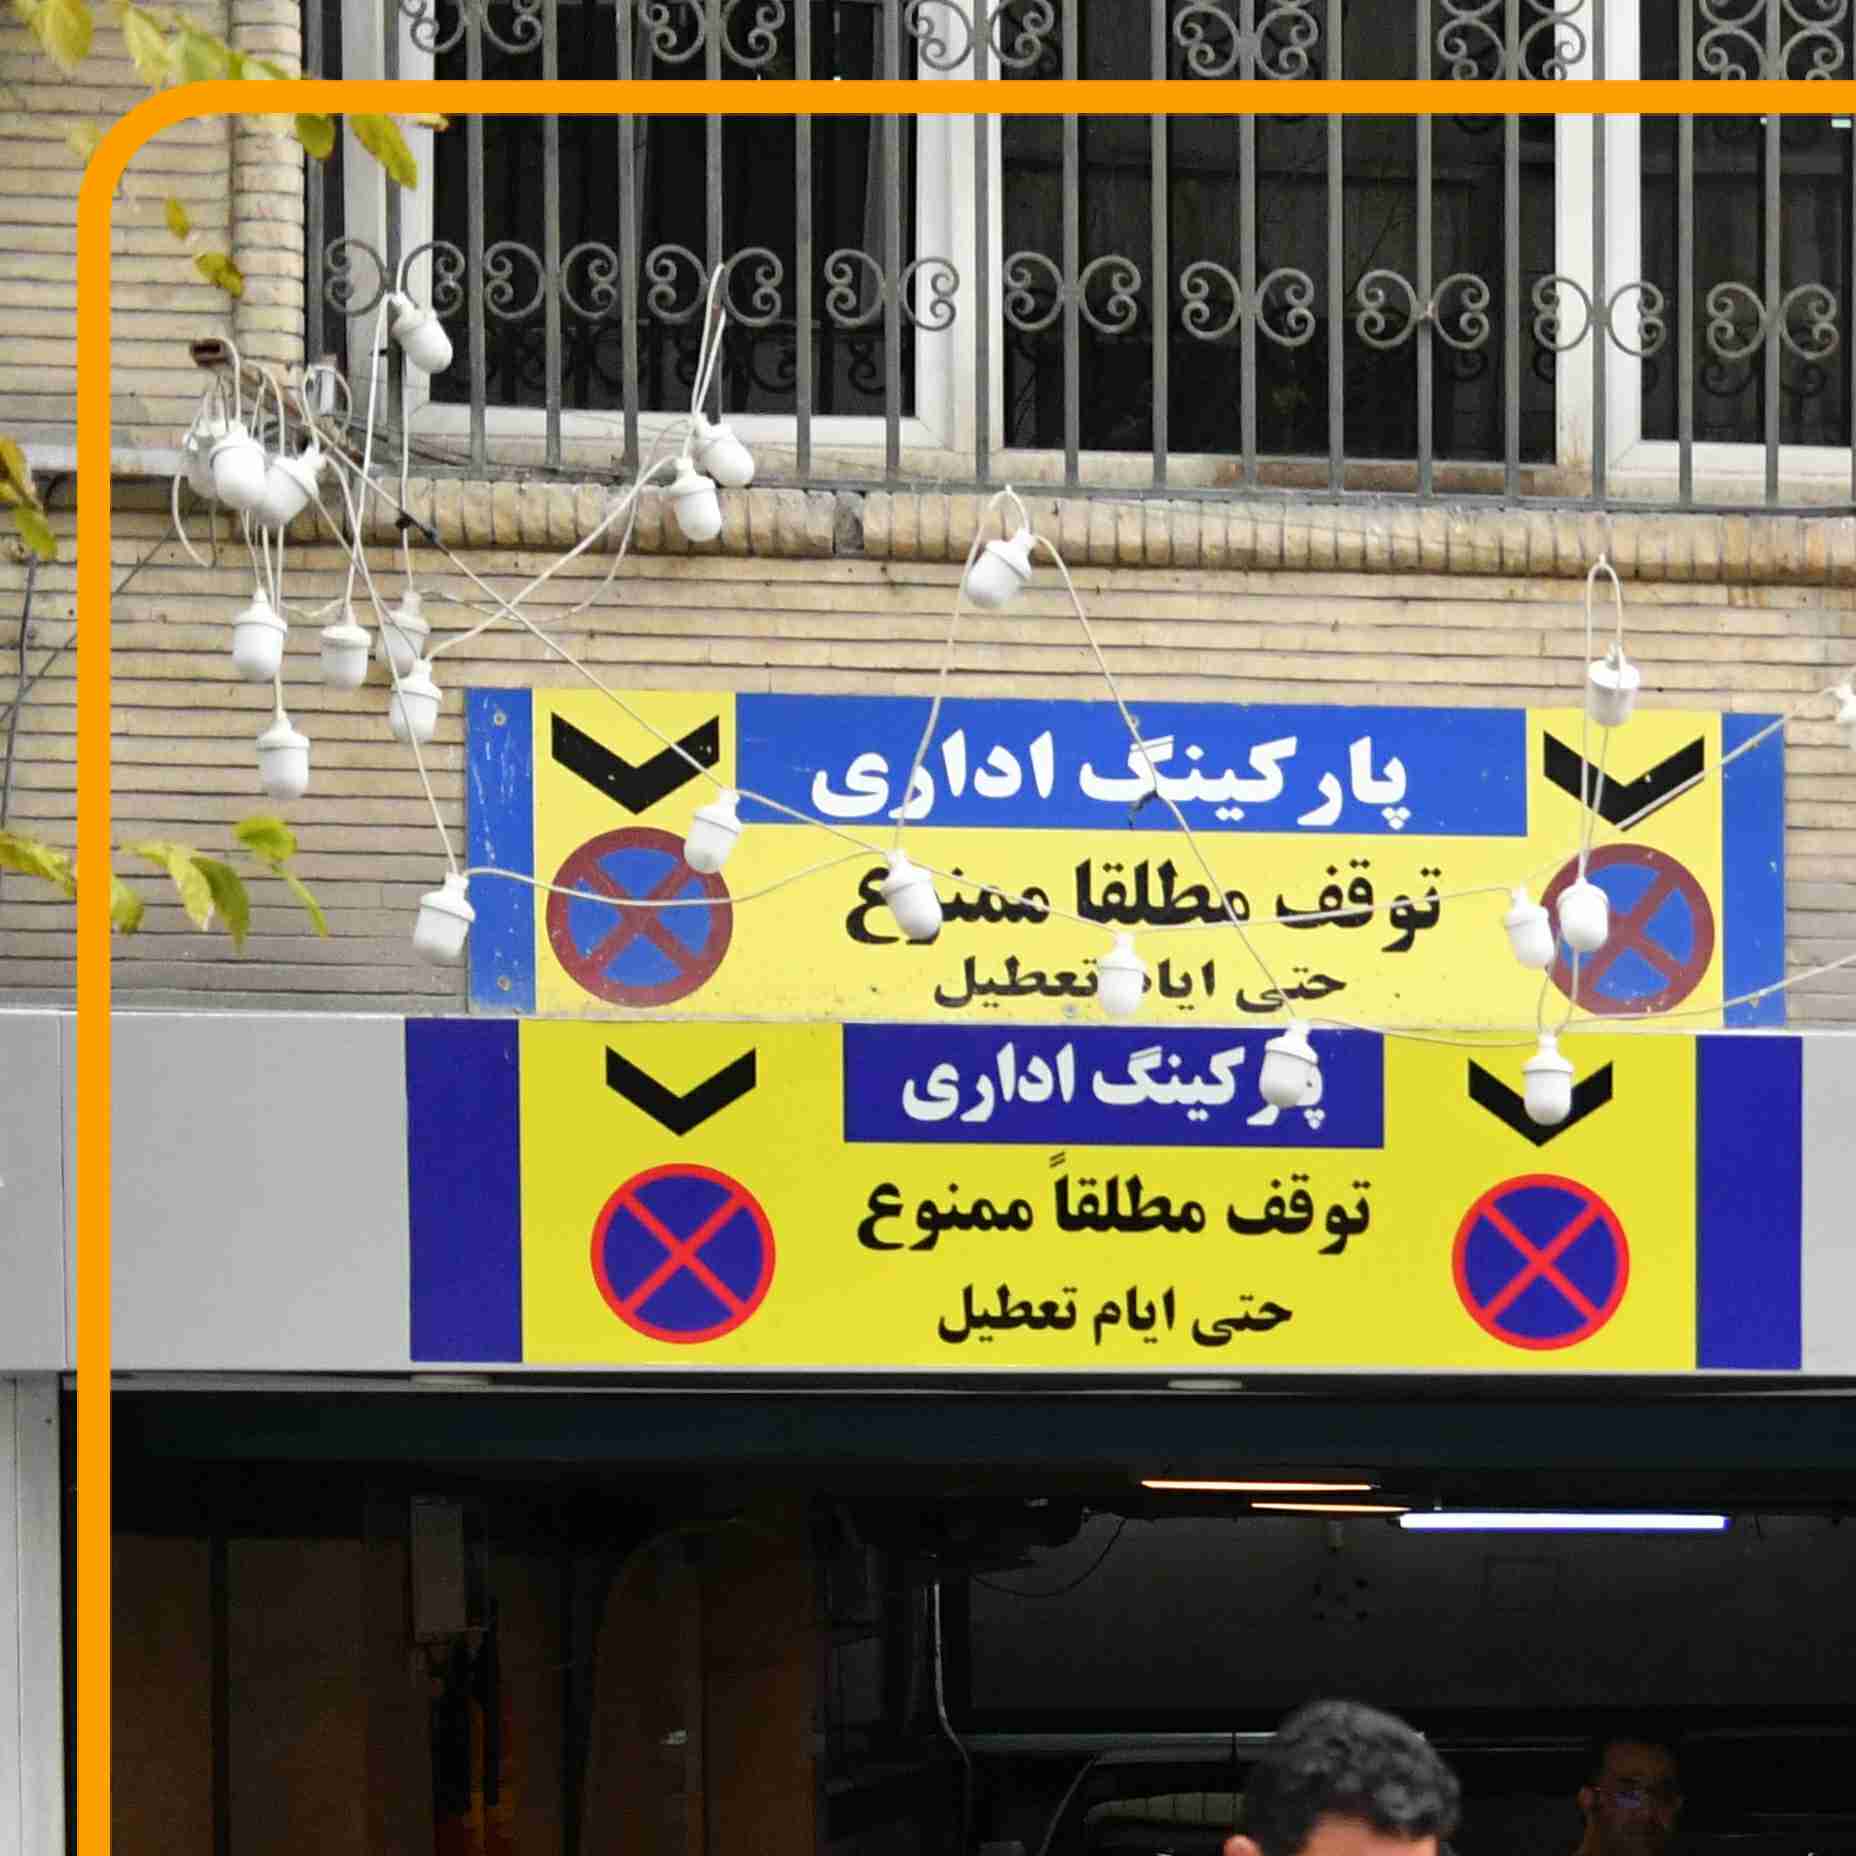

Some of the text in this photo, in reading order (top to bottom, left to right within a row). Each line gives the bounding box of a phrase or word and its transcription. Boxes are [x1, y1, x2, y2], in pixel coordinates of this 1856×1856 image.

[811, 728, 1412, 829] پارکینگ اداری
[1074, 857, 1251, 926] مطلقا
[1275, 858, 1441, 953] توقف
[934, 955, 1348, 1013] حتی ایا تعطیل
[902, 1042, 1075, 1123] اداری
[857, 1151, 1372, 1256] توقف مطلقاً ممنوع
[937, 1282, 1293, 1346] حتی ایام تعطیل
